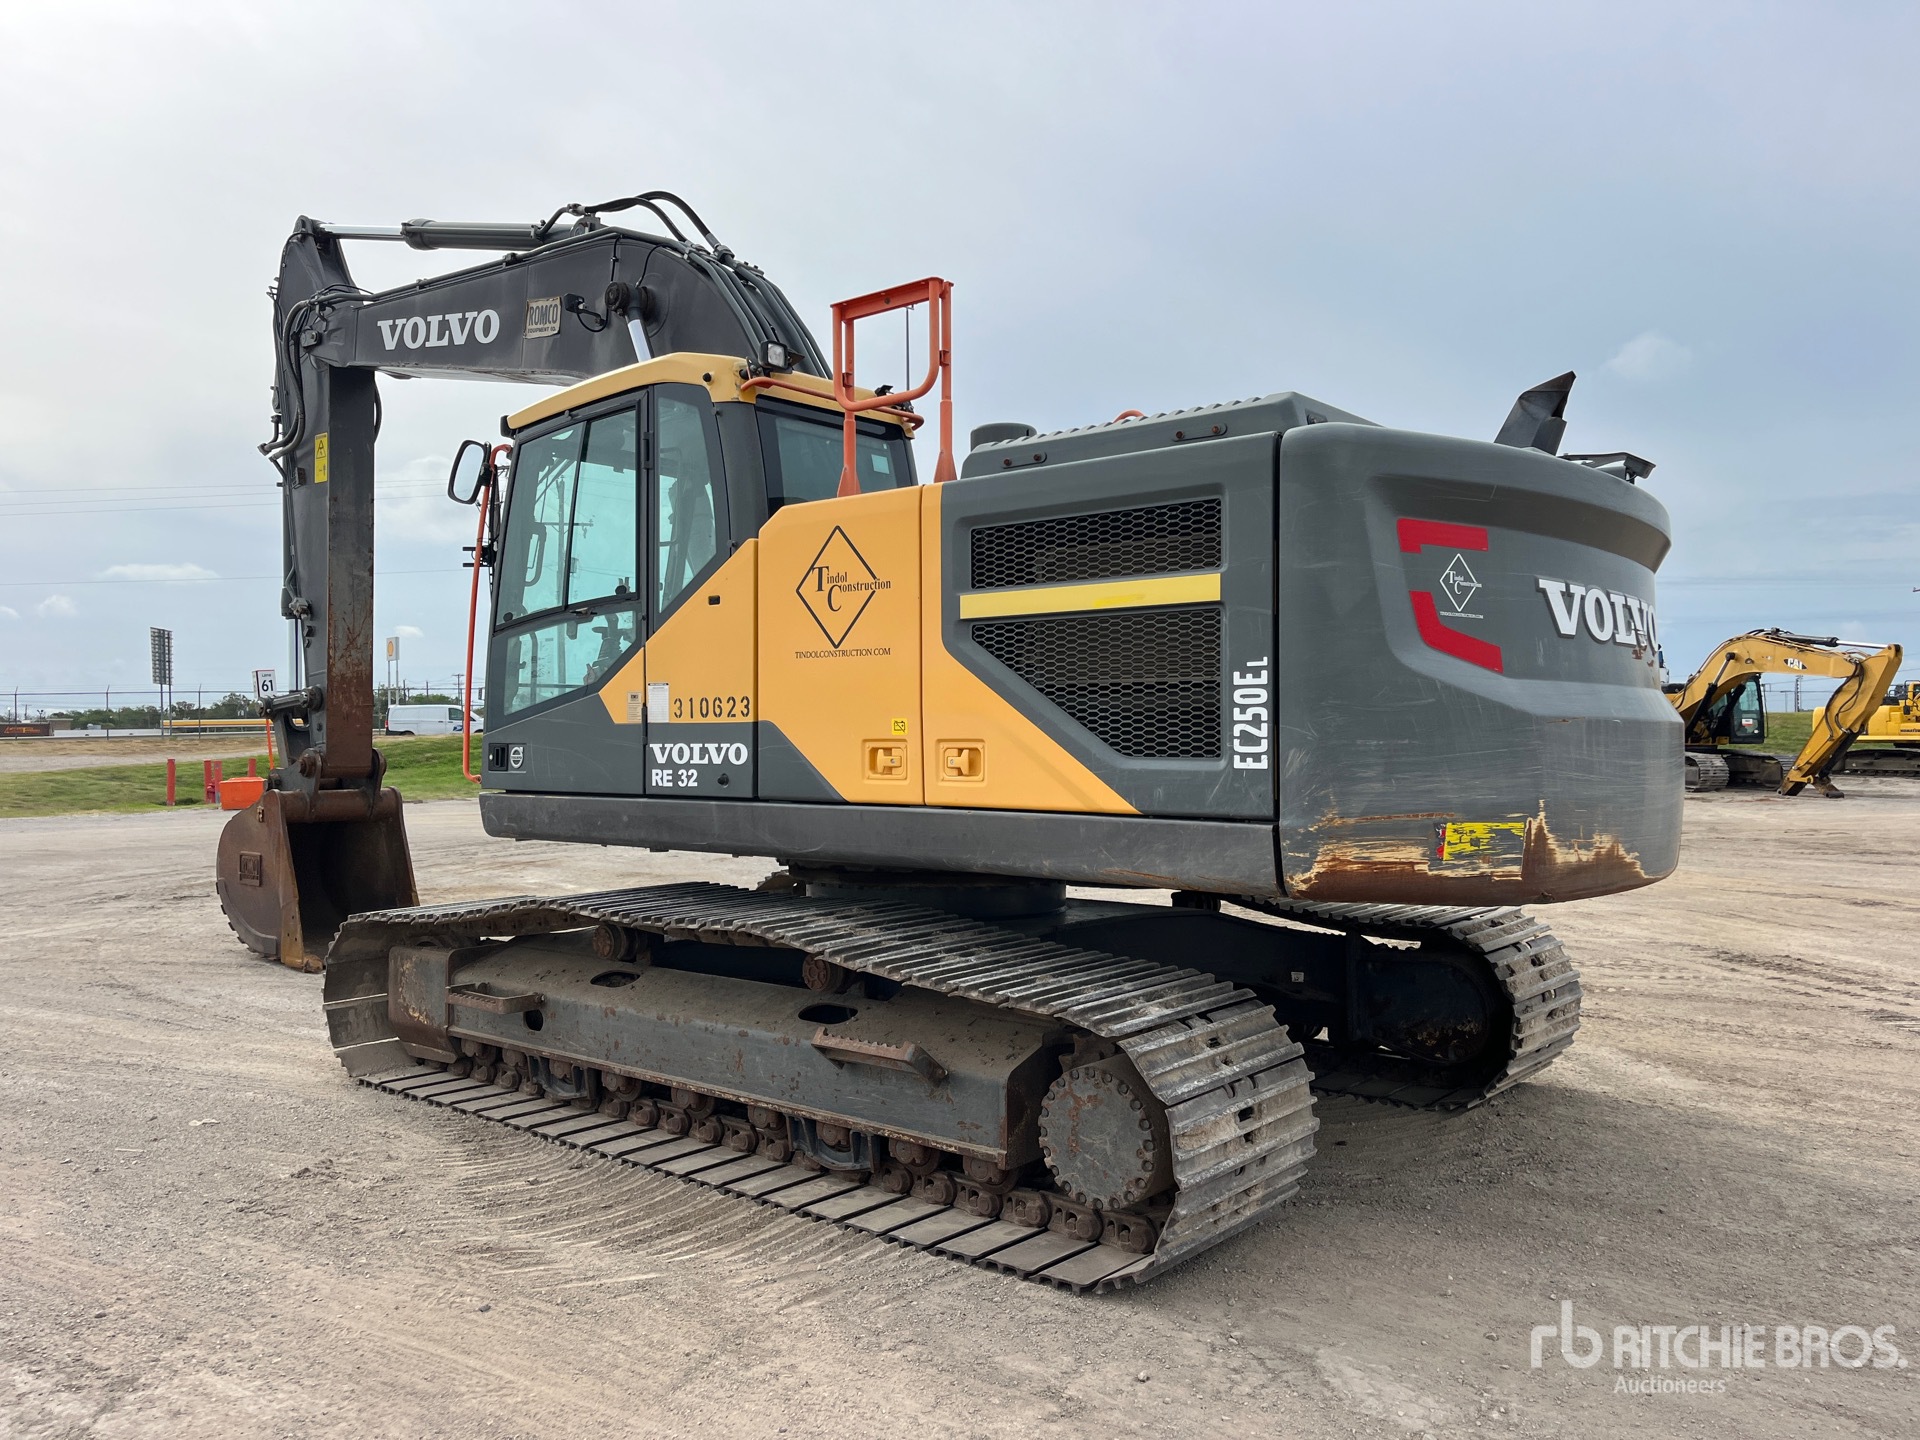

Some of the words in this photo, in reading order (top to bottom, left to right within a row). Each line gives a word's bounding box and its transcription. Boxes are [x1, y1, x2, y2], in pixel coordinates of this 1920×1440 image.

[528, 303, 559, 326] ROMCO
[377, 309, 500, 351] VOLVO
[811, 565, 848, 592] Tindol
[827, 578, 891, 612] Construction
[1537, 577, 1658, 652] VOLVO
[261, 679, 274, 692] 61
[673, 695, 750, 719] 310623
[649, 742, 748, 765] VOLVO
[651, 768, 673, 787] RE
[677, 768, 698, 787] 32
